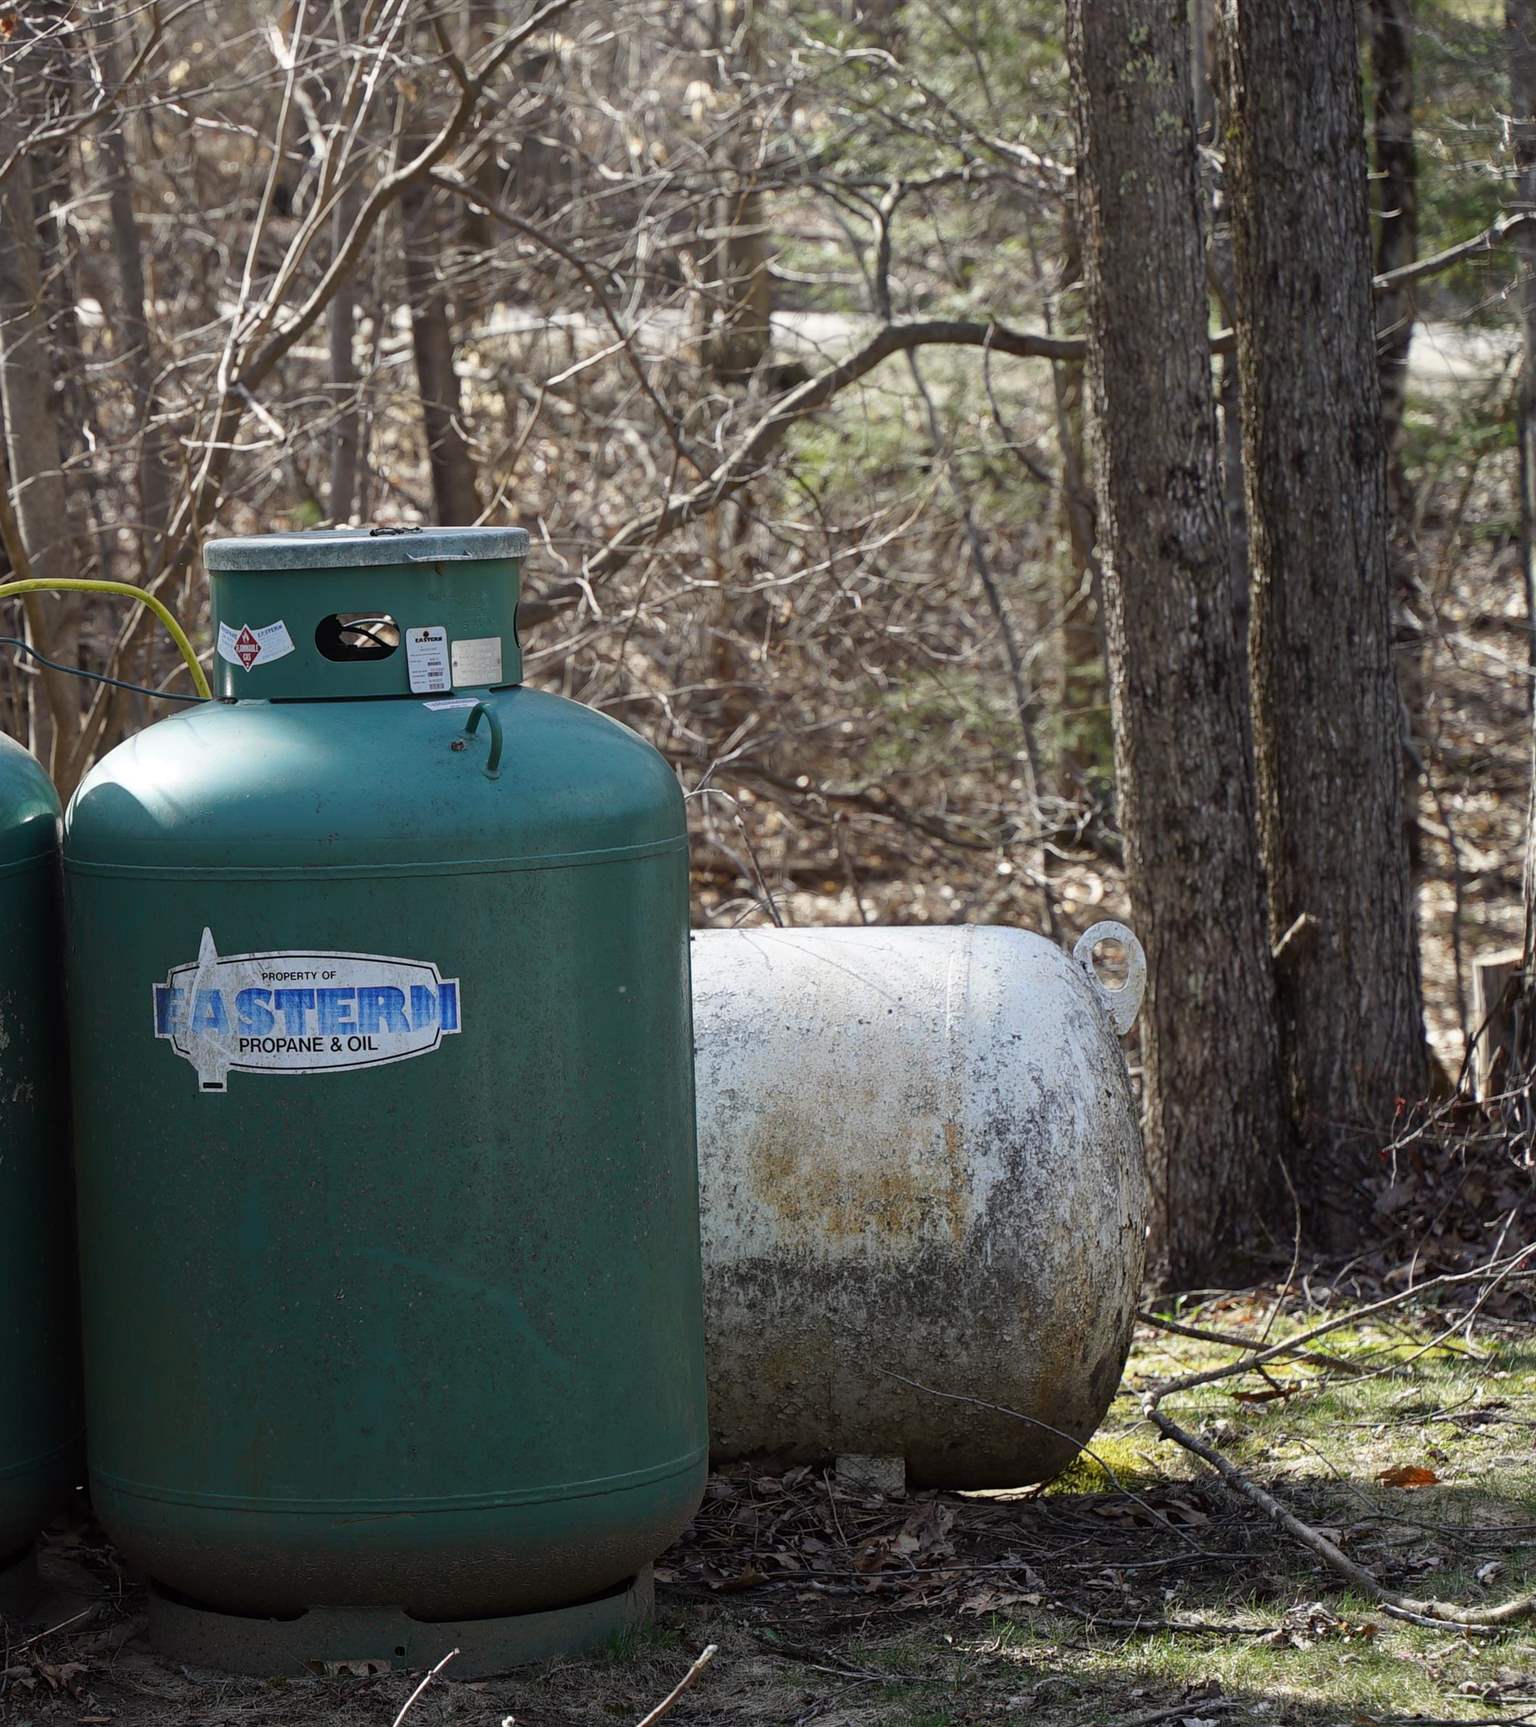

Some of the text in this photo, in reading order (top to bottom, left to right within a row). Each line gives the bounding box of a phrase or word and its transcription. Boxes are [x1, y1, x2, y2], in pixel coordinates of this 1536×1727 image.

[261, 970, 337, 981] PROPERTY OF
[156, 983, 458, 1036] EASTERN
[239, 1035, 379, 1053] PROPANE & OIL
